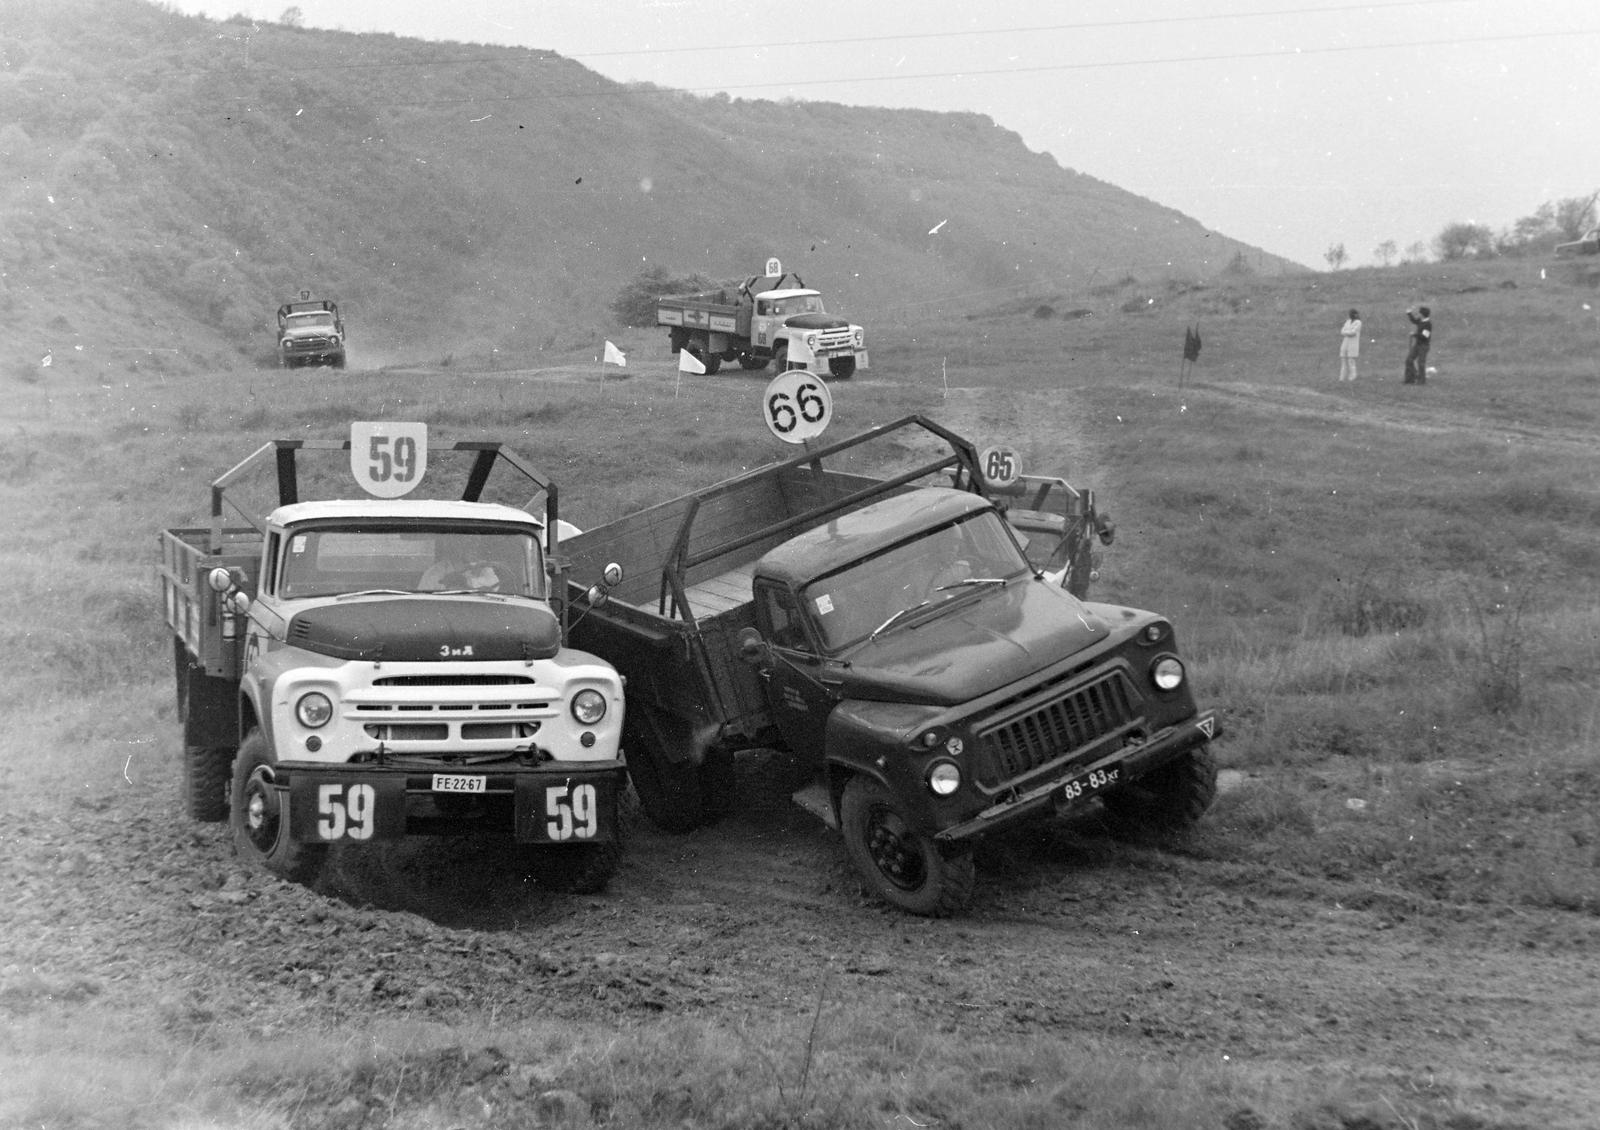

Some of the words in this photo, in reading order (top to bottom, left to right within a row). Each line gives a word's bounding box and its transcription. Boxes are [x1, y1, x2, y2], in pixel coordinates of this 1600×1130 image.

[769, 383, 825, 433] 66
[369, 436, 416, 483] 59
[987, 451, 1013, 481] 65
[318, 784, 375, 840] 59
[546, 784, 597, 841] 59
